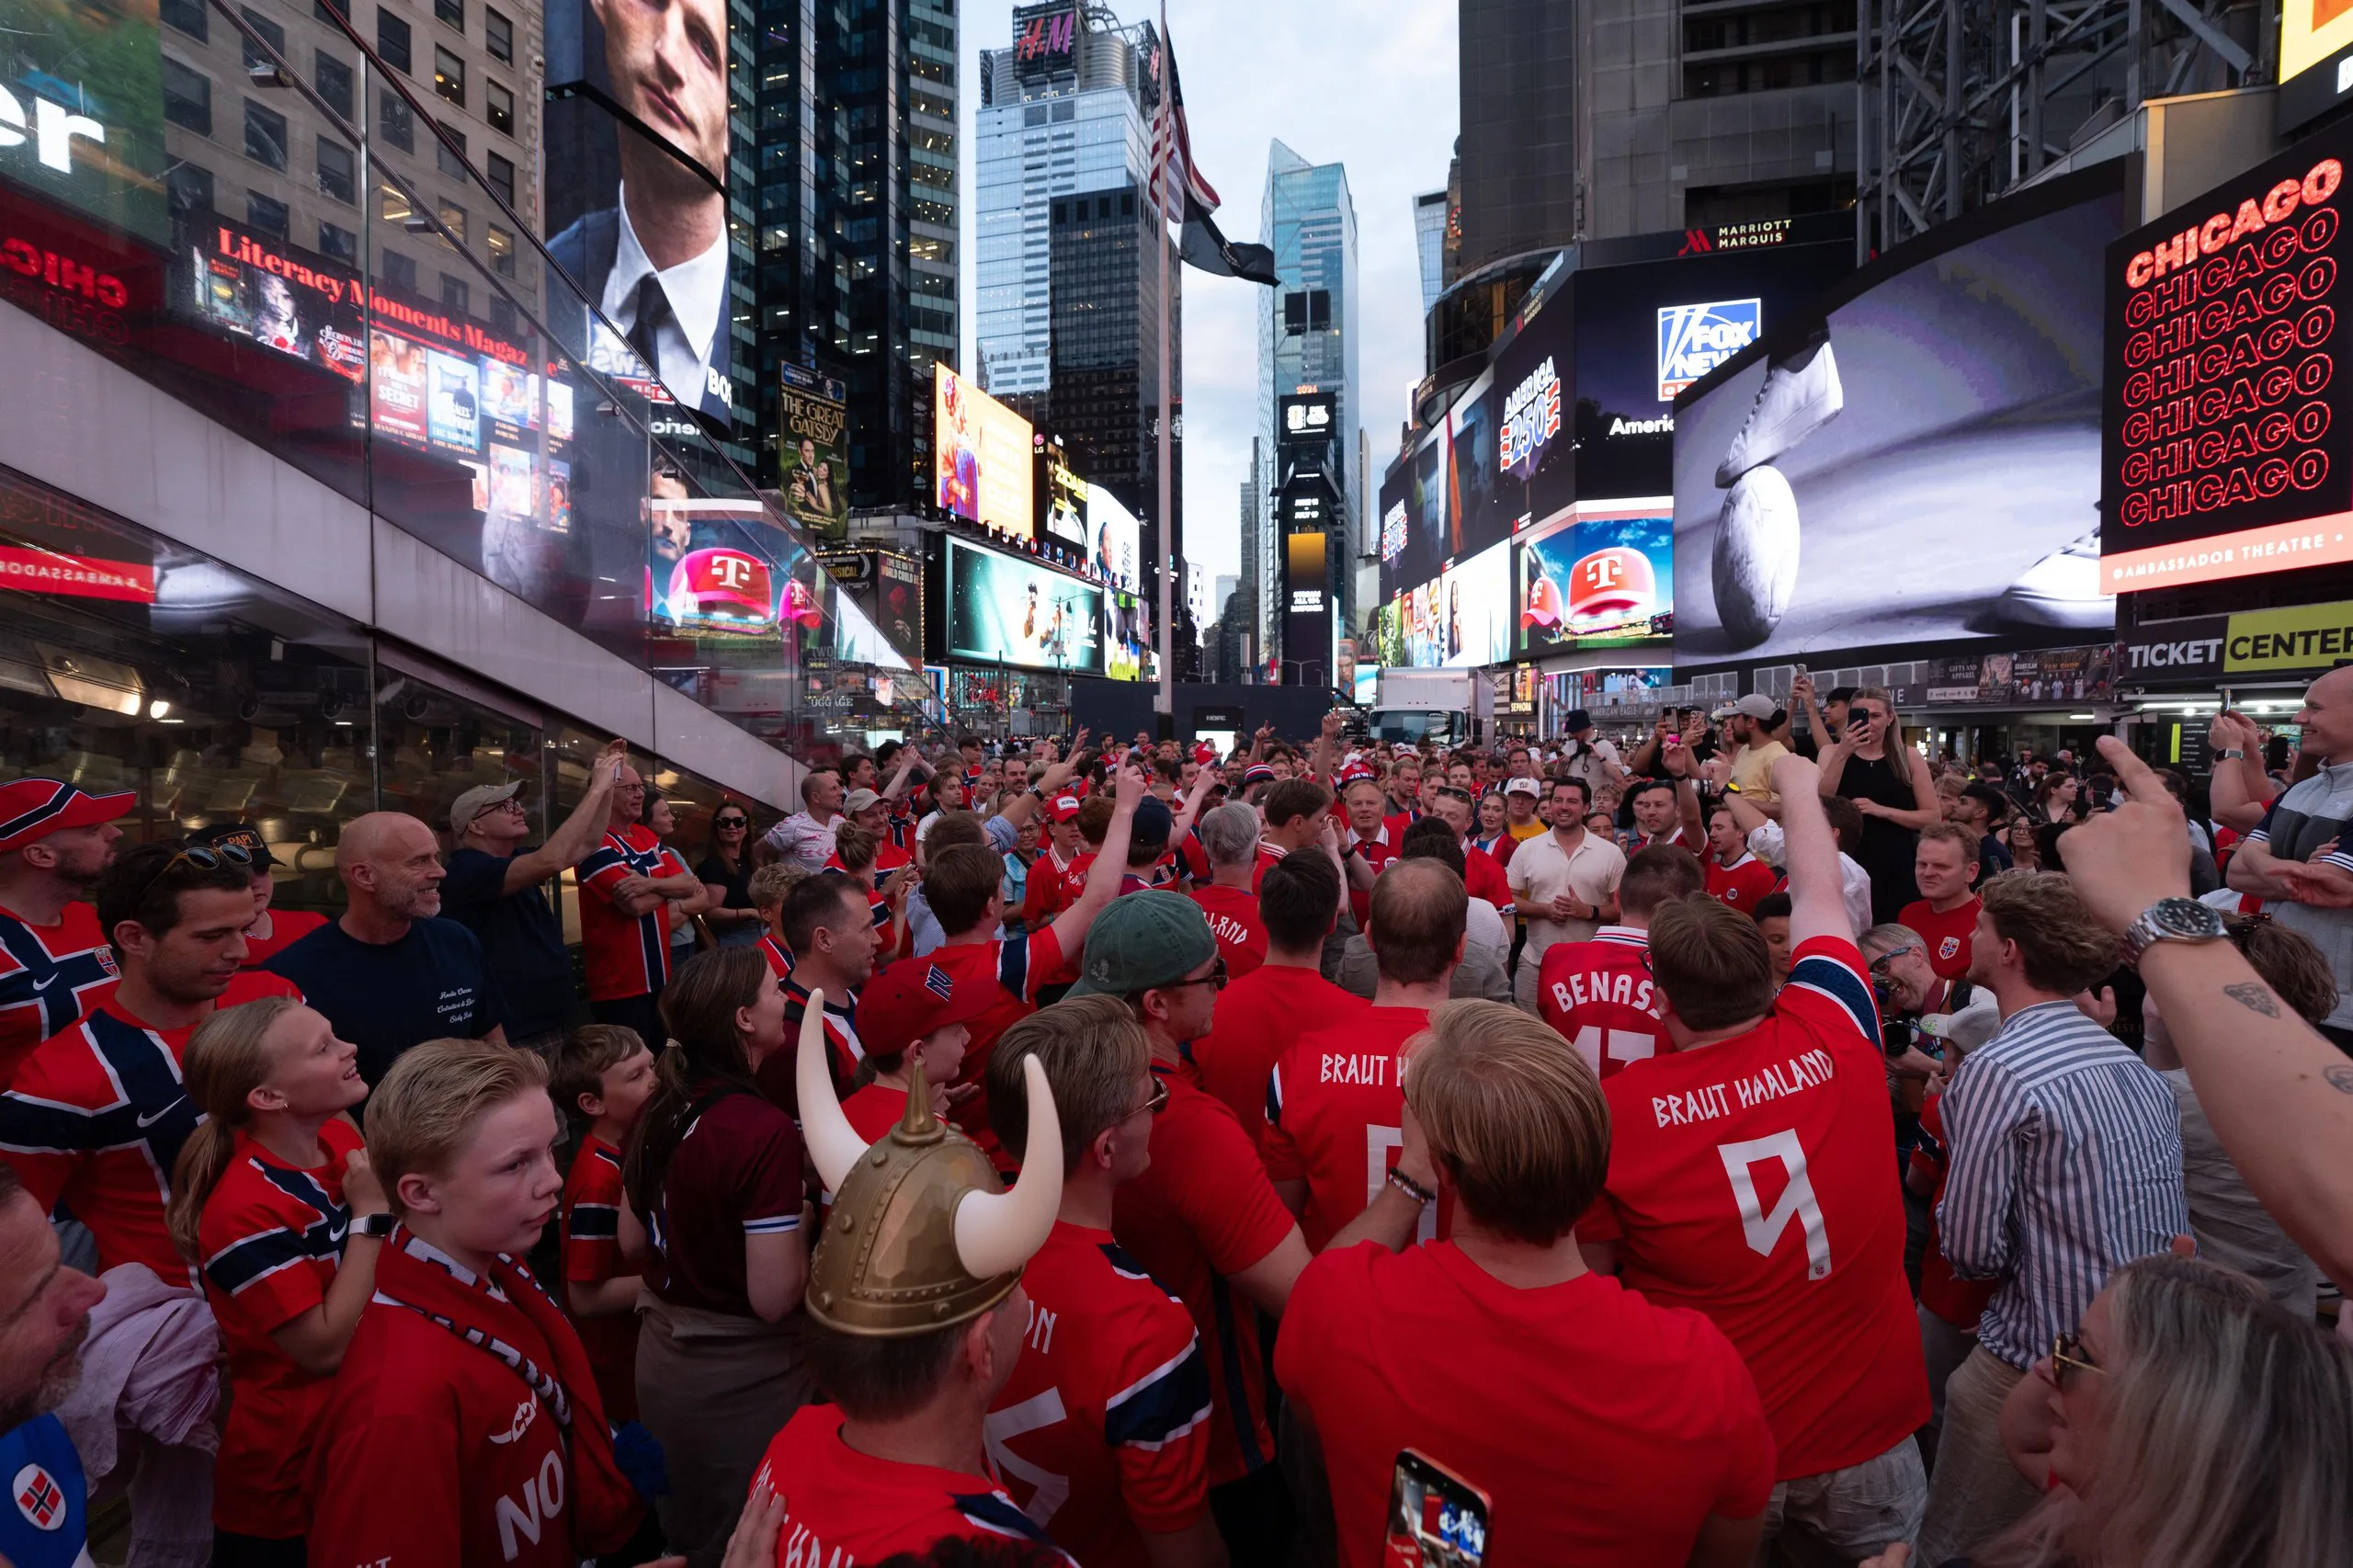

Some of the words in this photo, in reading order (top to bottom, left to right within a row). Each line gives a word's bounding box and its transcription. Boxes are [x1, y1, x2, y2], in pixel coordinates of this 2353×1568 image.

[1017, 12, 1074, 61] H&M
[1719, 220, 1791, 236] MARRIOTT
[1719, 233, 1782, 248] MARQUIS
[2126, 158, 2342, 289] CHICAGO
[219, 227, 347, 304] Literacy
[349, 278, 463, 343] Moments
[2125, 208, 2339, 328] CHICAGO
[1690, 321, 1754, 352] FOX
[2124, 256, 2336, 368] CHICAGO
[2123, 305, 2335, 408] CHICAGO
[378, 384, 420, 410] SECRET
[781, 392, 804, 416] THE
[806, 403, 845, 431] GREAT
[1504, 356, 1555, 424] AMERICA
[2122, 353, 2333, 448] CHICAGO
[790, 415, 838, 445] GATSBY
[1510, 392, 1548, 463] 250
[2121, 401, 2331, 487] CHICAGO
[2120, 449, 2329, 527] CHICAGO
[2242, 534, 2325, 560] THEATRE
[2128, 638, 2223, 668] TICKET
[2229, 627, 2353, 661] CENTER
[1951, 671, 1975, 680] APPAREL
[1510, 701, 1532, 712] SEPHORA
[1592, 707, 1618, 717] AMERICAN
[1620, 705, 1638, 716] EAGLE
[227, 834, 253, 846] PAPI
[1552, 970, 1661, 1020] BENAS
[1320, 1053, 1388, 1085] BRAUT
[1652, 1082, 1731, 1129] BRAUT
[1737, 1049, 1835, 1108] HAALAND
[1717, 1128, 1832, 1281] 9
